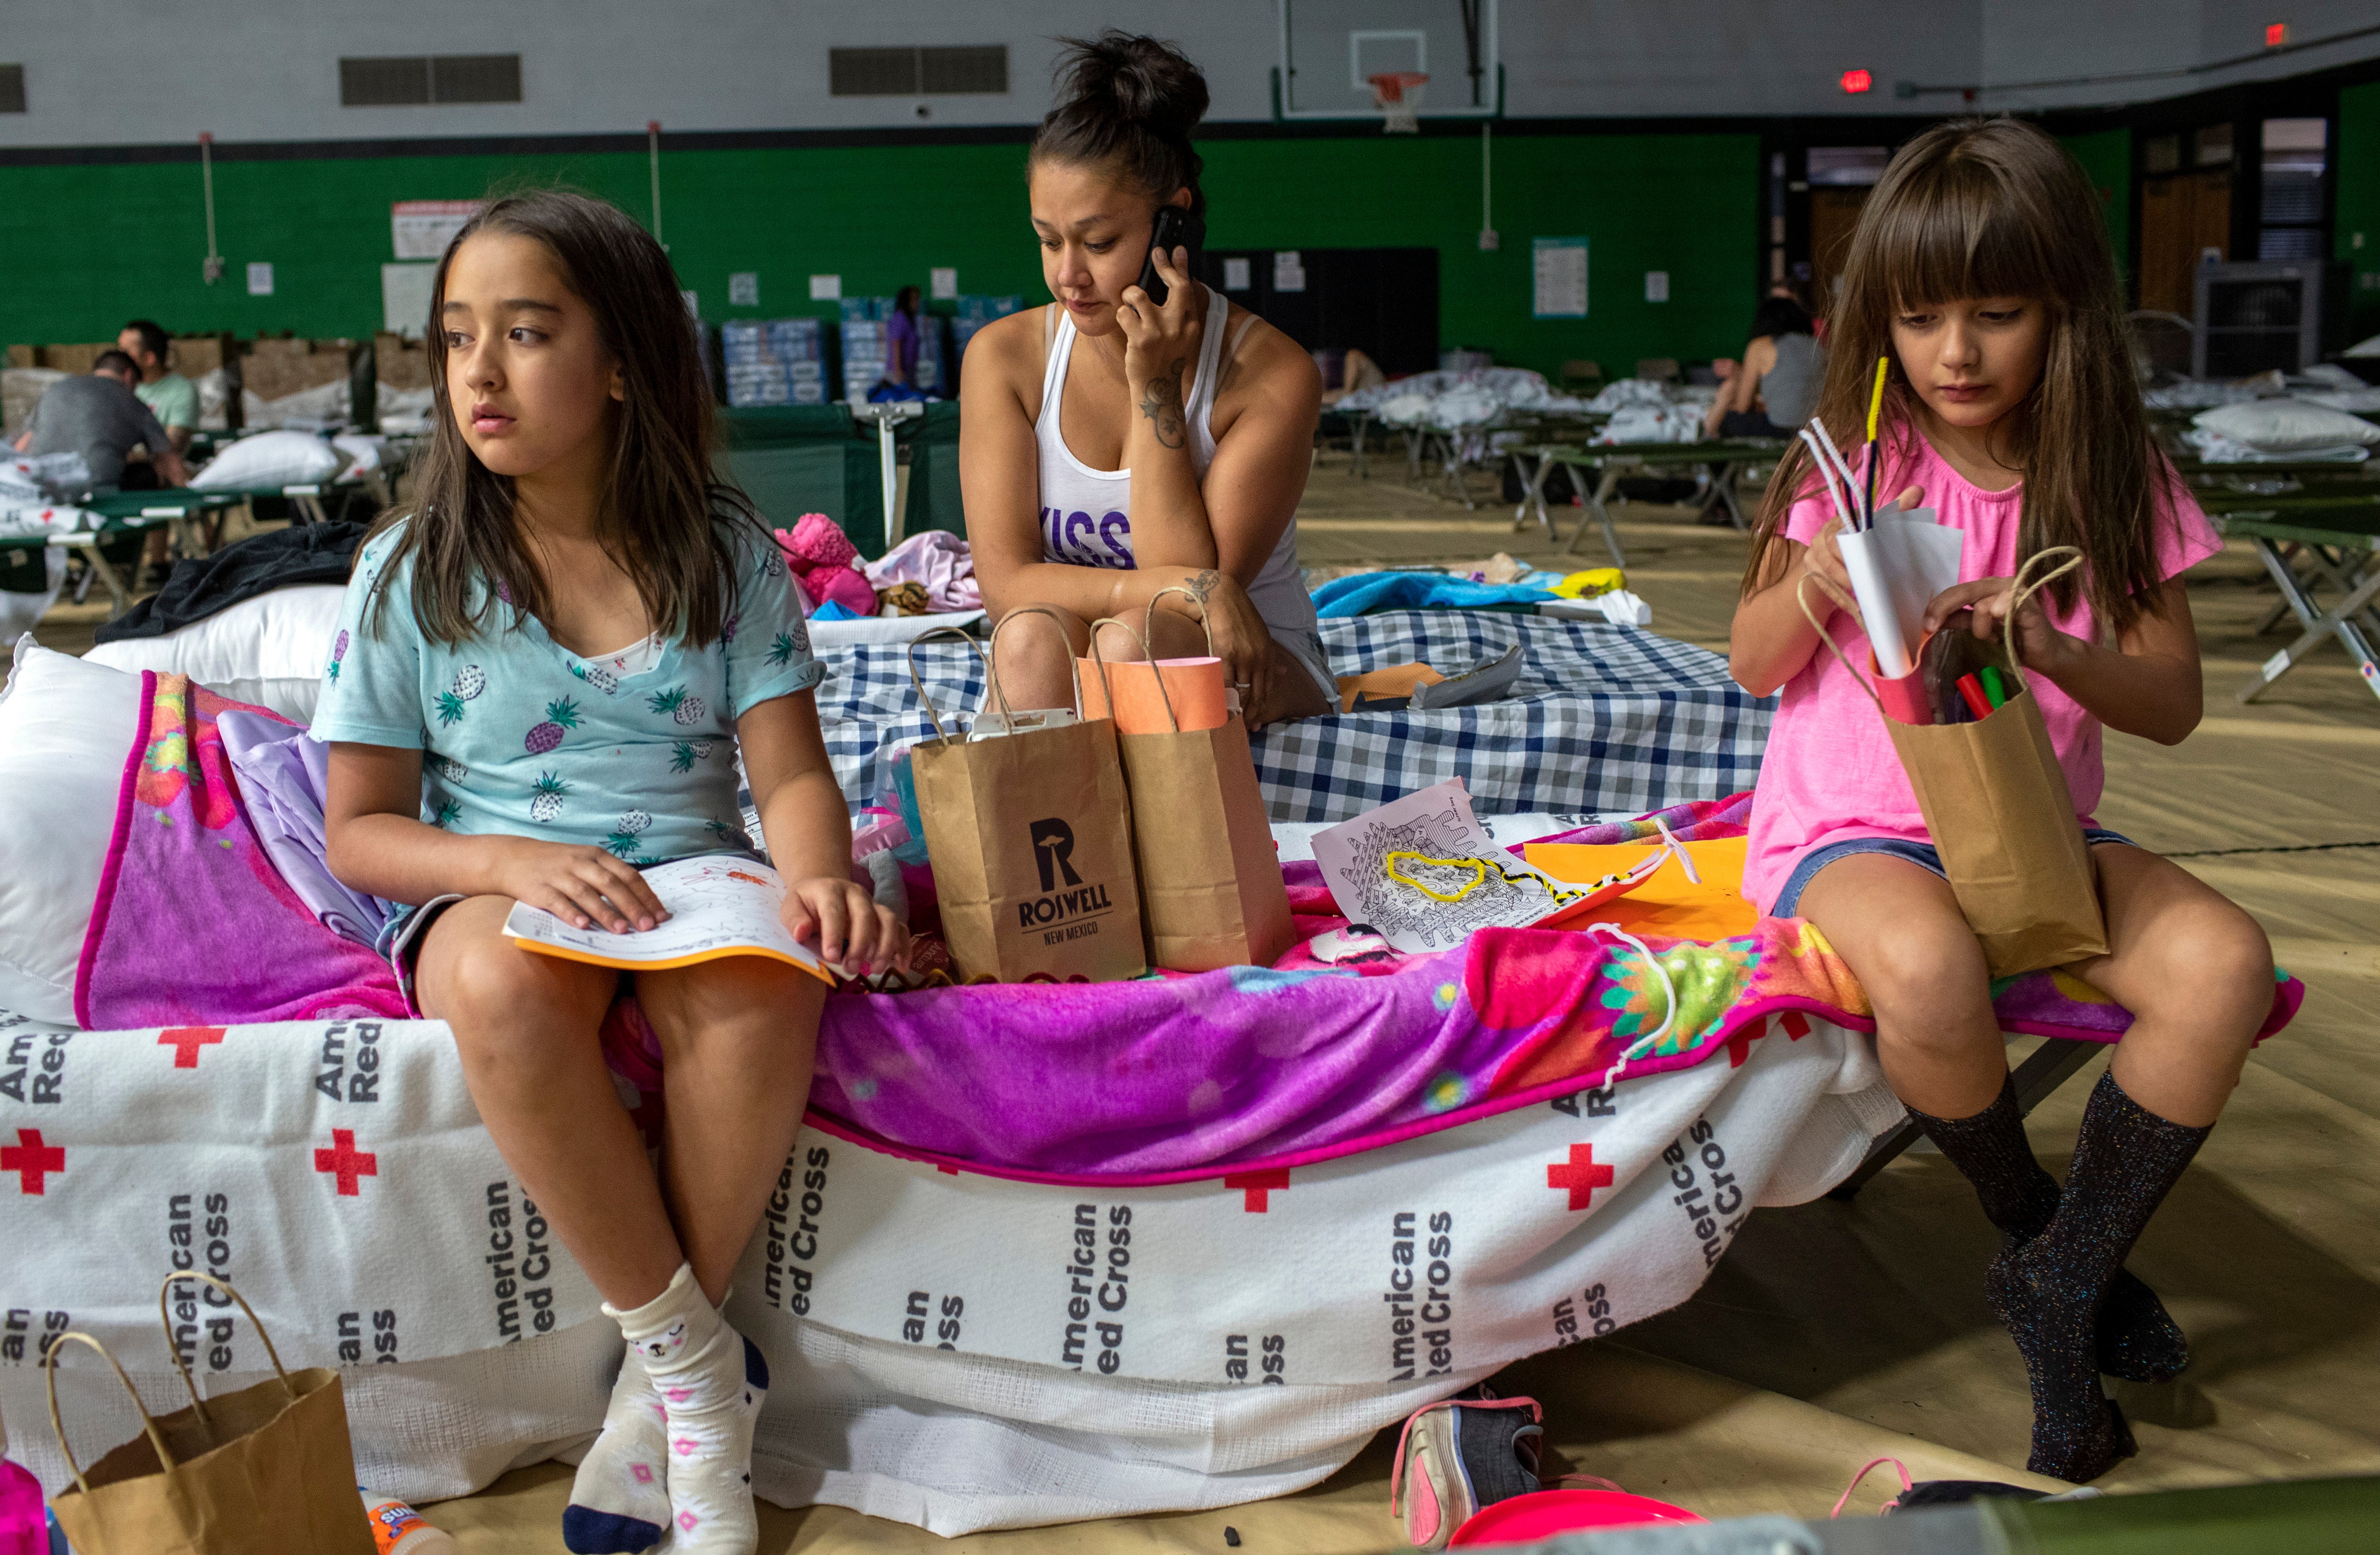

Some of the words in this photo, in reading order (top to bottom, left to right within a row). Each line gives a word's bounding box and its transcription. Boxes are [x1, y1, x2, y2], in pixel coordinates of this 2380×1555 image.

[1018, 884, 1112, 927] ROSWELL
[1044, 929, 1064, 946] NEW
[1066, 921, 1098, 941] MEXICO
[315, 1020, 349, 1102] Am
[349, 1022, 383, 1103] Red
[791, 1147, 830, 1261] Cross
[1689, 1112, 1743, 1215] Cros
[486, 1180, 522, 1343] merican
[765, 1144, 796, 1309] merica
[1098, 1205, 1132, 1312] Cross
[1421, 1210, 1452, 1323] Cross
[166, 1194, 198, 1374] mercan
[524, 1286, 556, 1337] ed
[1062, 1203, 1097, 1372] merican
[1, 1309, 30, 1367] an
[205, 1318, 234, 1373] ed
[338, 1312, 361, 1367] an
[1226, 1334, 1248, 1384] an
